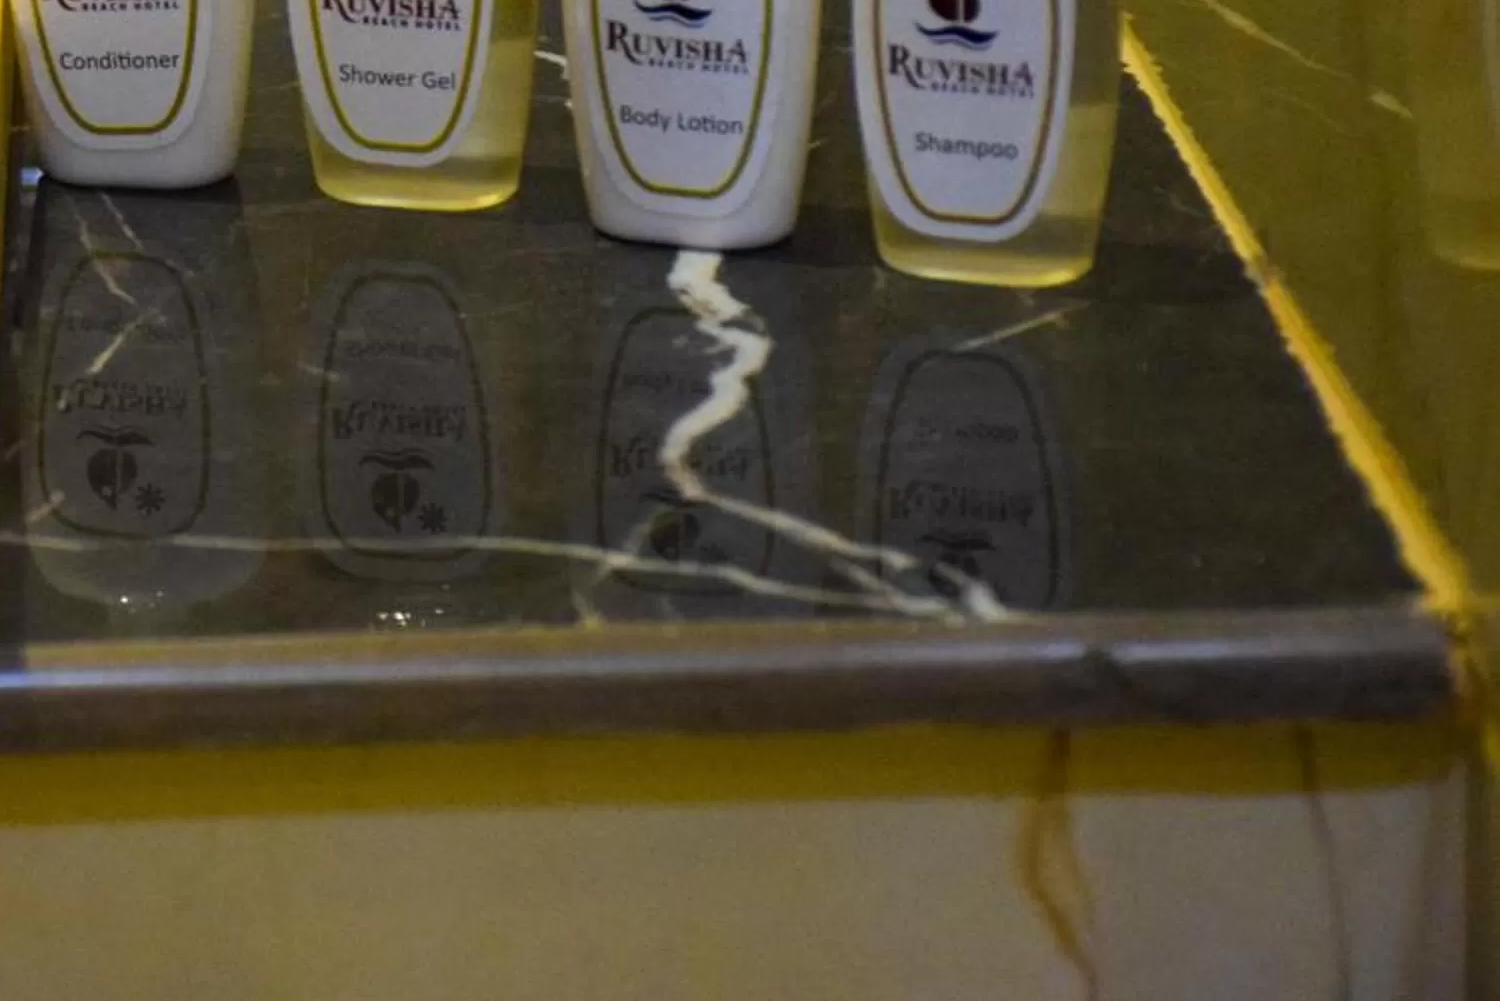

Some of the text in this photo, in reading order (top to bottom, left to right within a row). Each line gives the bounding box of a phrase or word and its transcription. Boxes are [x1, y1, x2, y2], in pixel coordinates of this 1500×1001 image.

[133, 0, 181, 11] HOTEL
[606, 20, 748, 66] RUVISHA
[59, 51, 182, 72] Conditioner
[888, 42, 1034, 91] RUVISHA
[339, 63, 457, 92] Shower Gel
[619, 104, 744, 135] Body Lotion
[914, 131, 1020, 162] Shampoo
